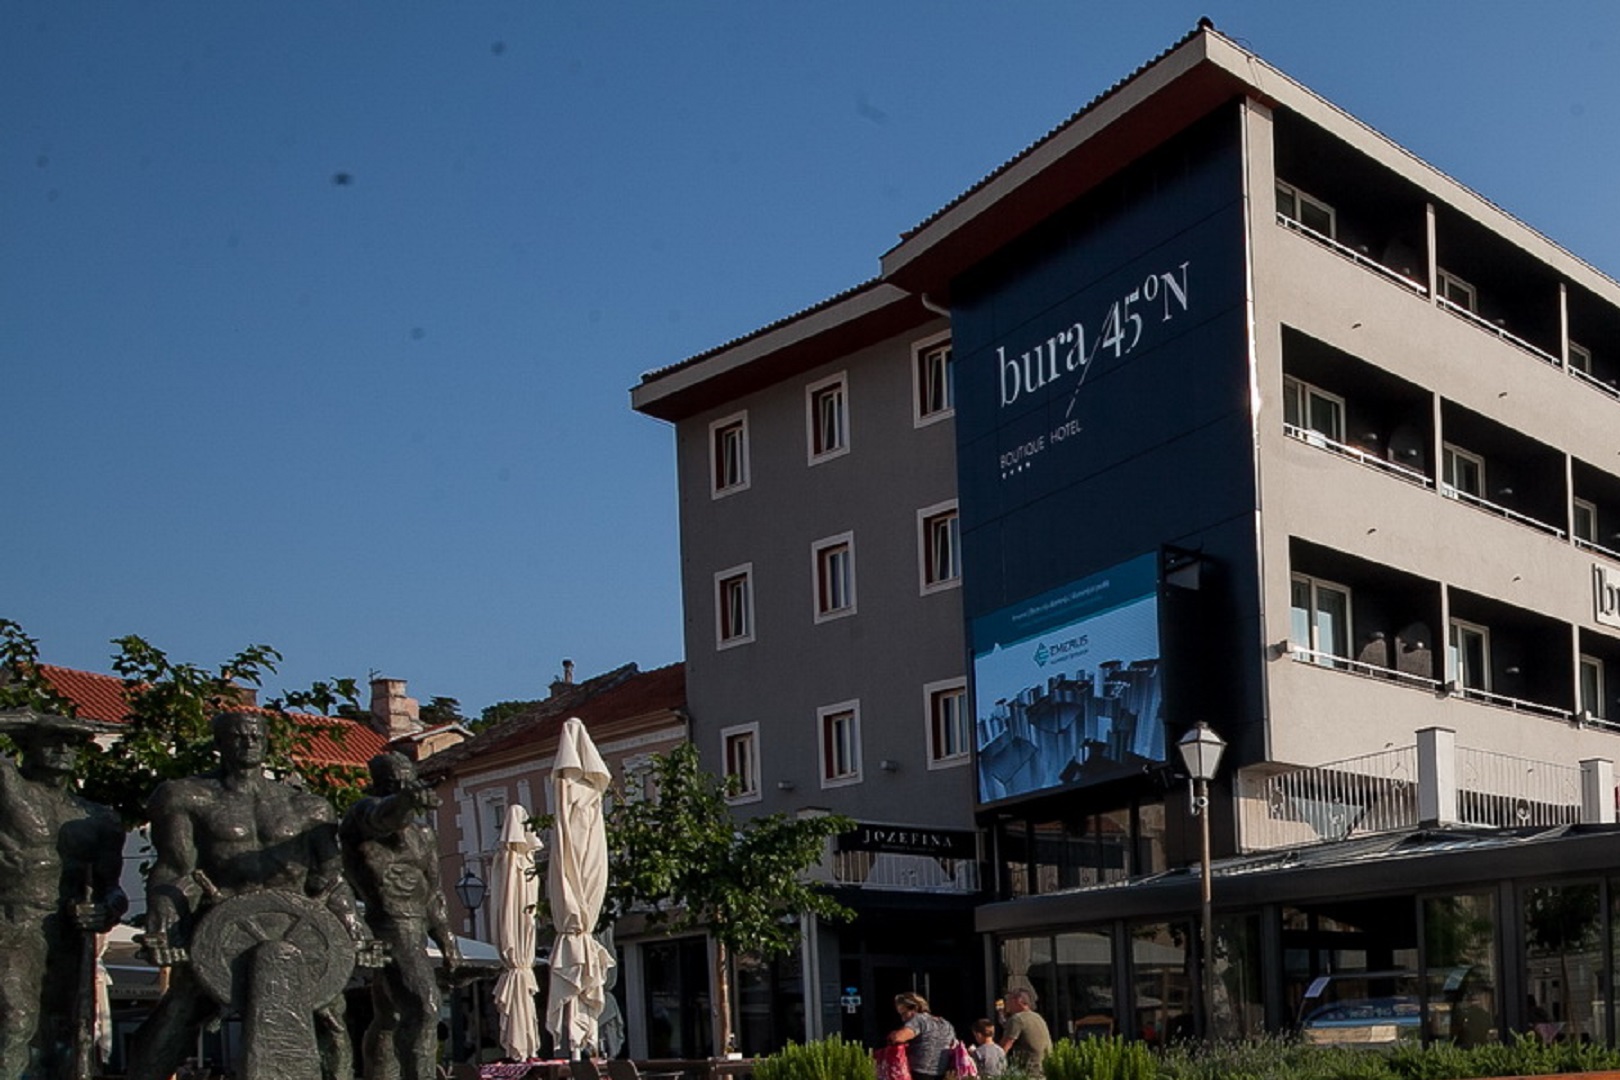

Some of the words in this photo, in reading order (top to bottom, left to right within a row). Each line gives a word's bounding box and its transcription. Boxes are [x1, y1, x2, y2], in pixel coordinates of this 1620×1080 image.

[996, 323, 1088, 408] bura
[1000, 435, 1045, 469] BOUTIQUE
[1050, 419, 1083, 444] HOTEL
[863, 829, 953, 848] JOZEFINA
